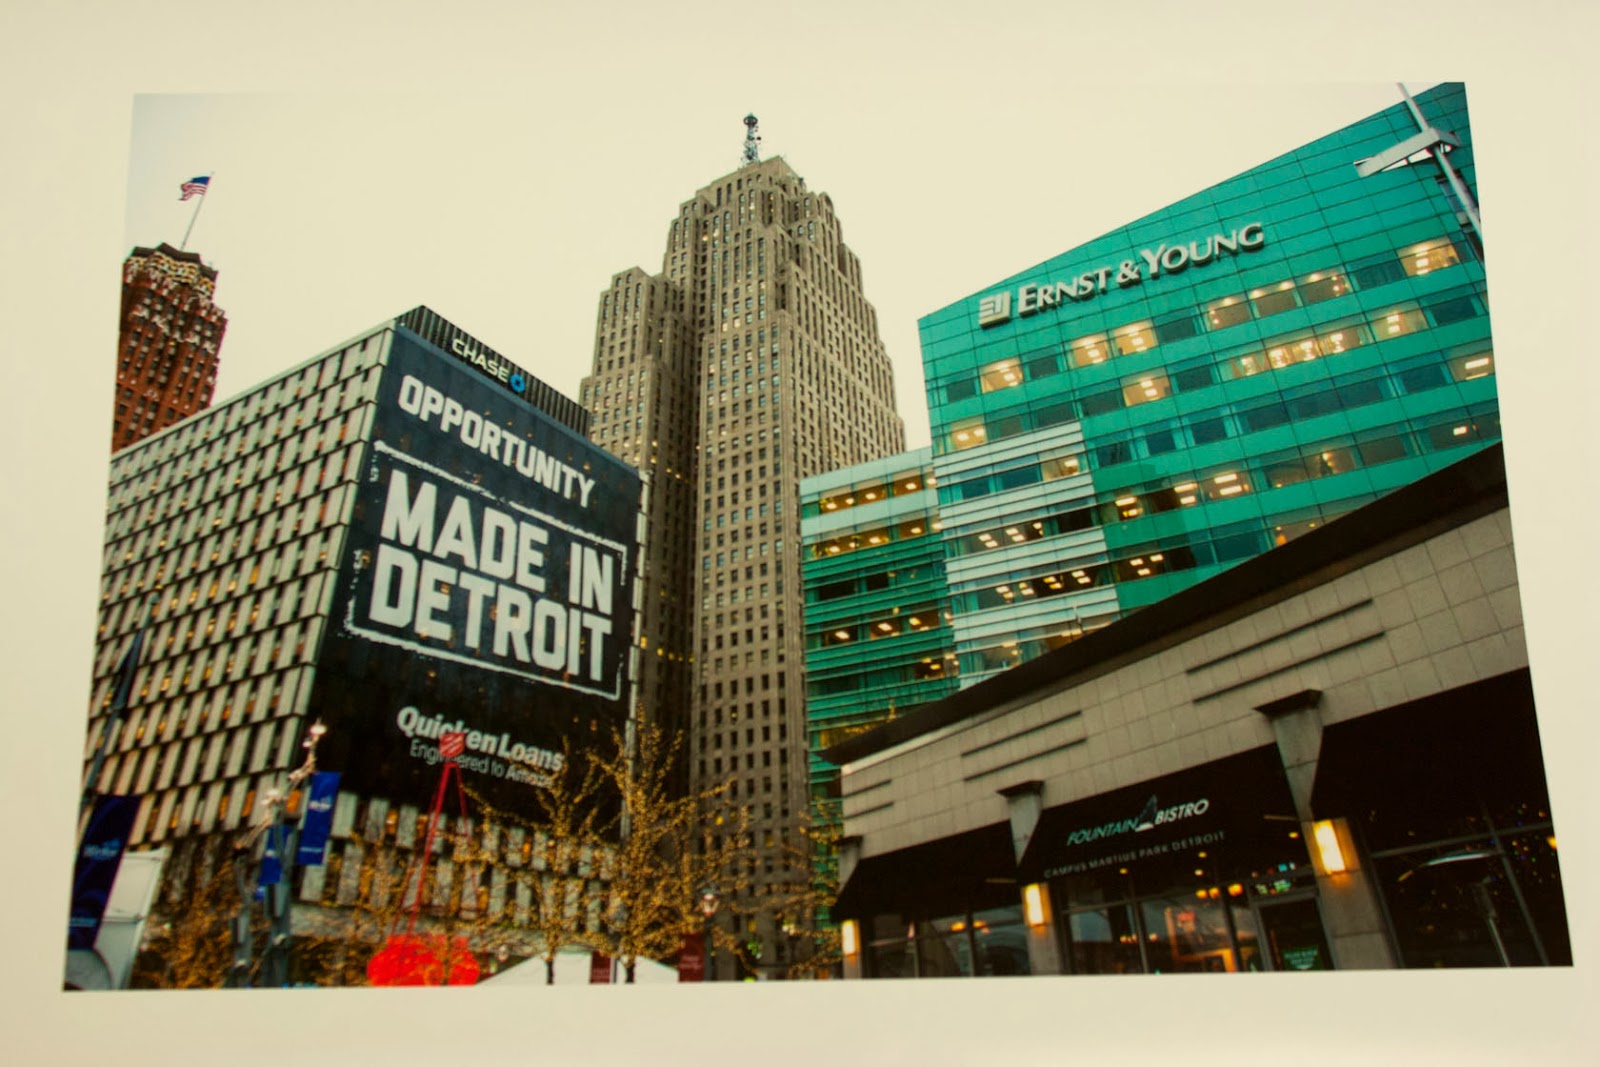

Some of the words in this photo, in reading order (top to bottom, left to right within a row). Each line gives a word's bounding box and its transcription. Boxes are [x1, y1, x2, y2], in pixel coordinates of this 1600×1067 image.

[1017, 266, 1111, 317] ERNST
[1115, 259, 1142, 288] &
[1140, 223, 1265, 280] YOUNG
[452, 338, 509, 383] CHASE
[398, 374, 596, 508] OPPORTUNITY
[380, 469, 549, 593] MADE
[569, 542, 613, 615] IN
[368, 543, 613, 683] DETROIT
[491, 762, 505, 777] to
[498, 733, 565, 772] Loans
[1066, 817, 1140, 846] FOUNTAIN
[1154, 798, 1209, 825] BISTRO
[1043, 864, 1087, 879] CAMPUS
[1089, 851, 1137, 869] MARTIUS
[1139, 845, 1168, 858] PARK
[1172, 831, 1226, 852] DETROIT
